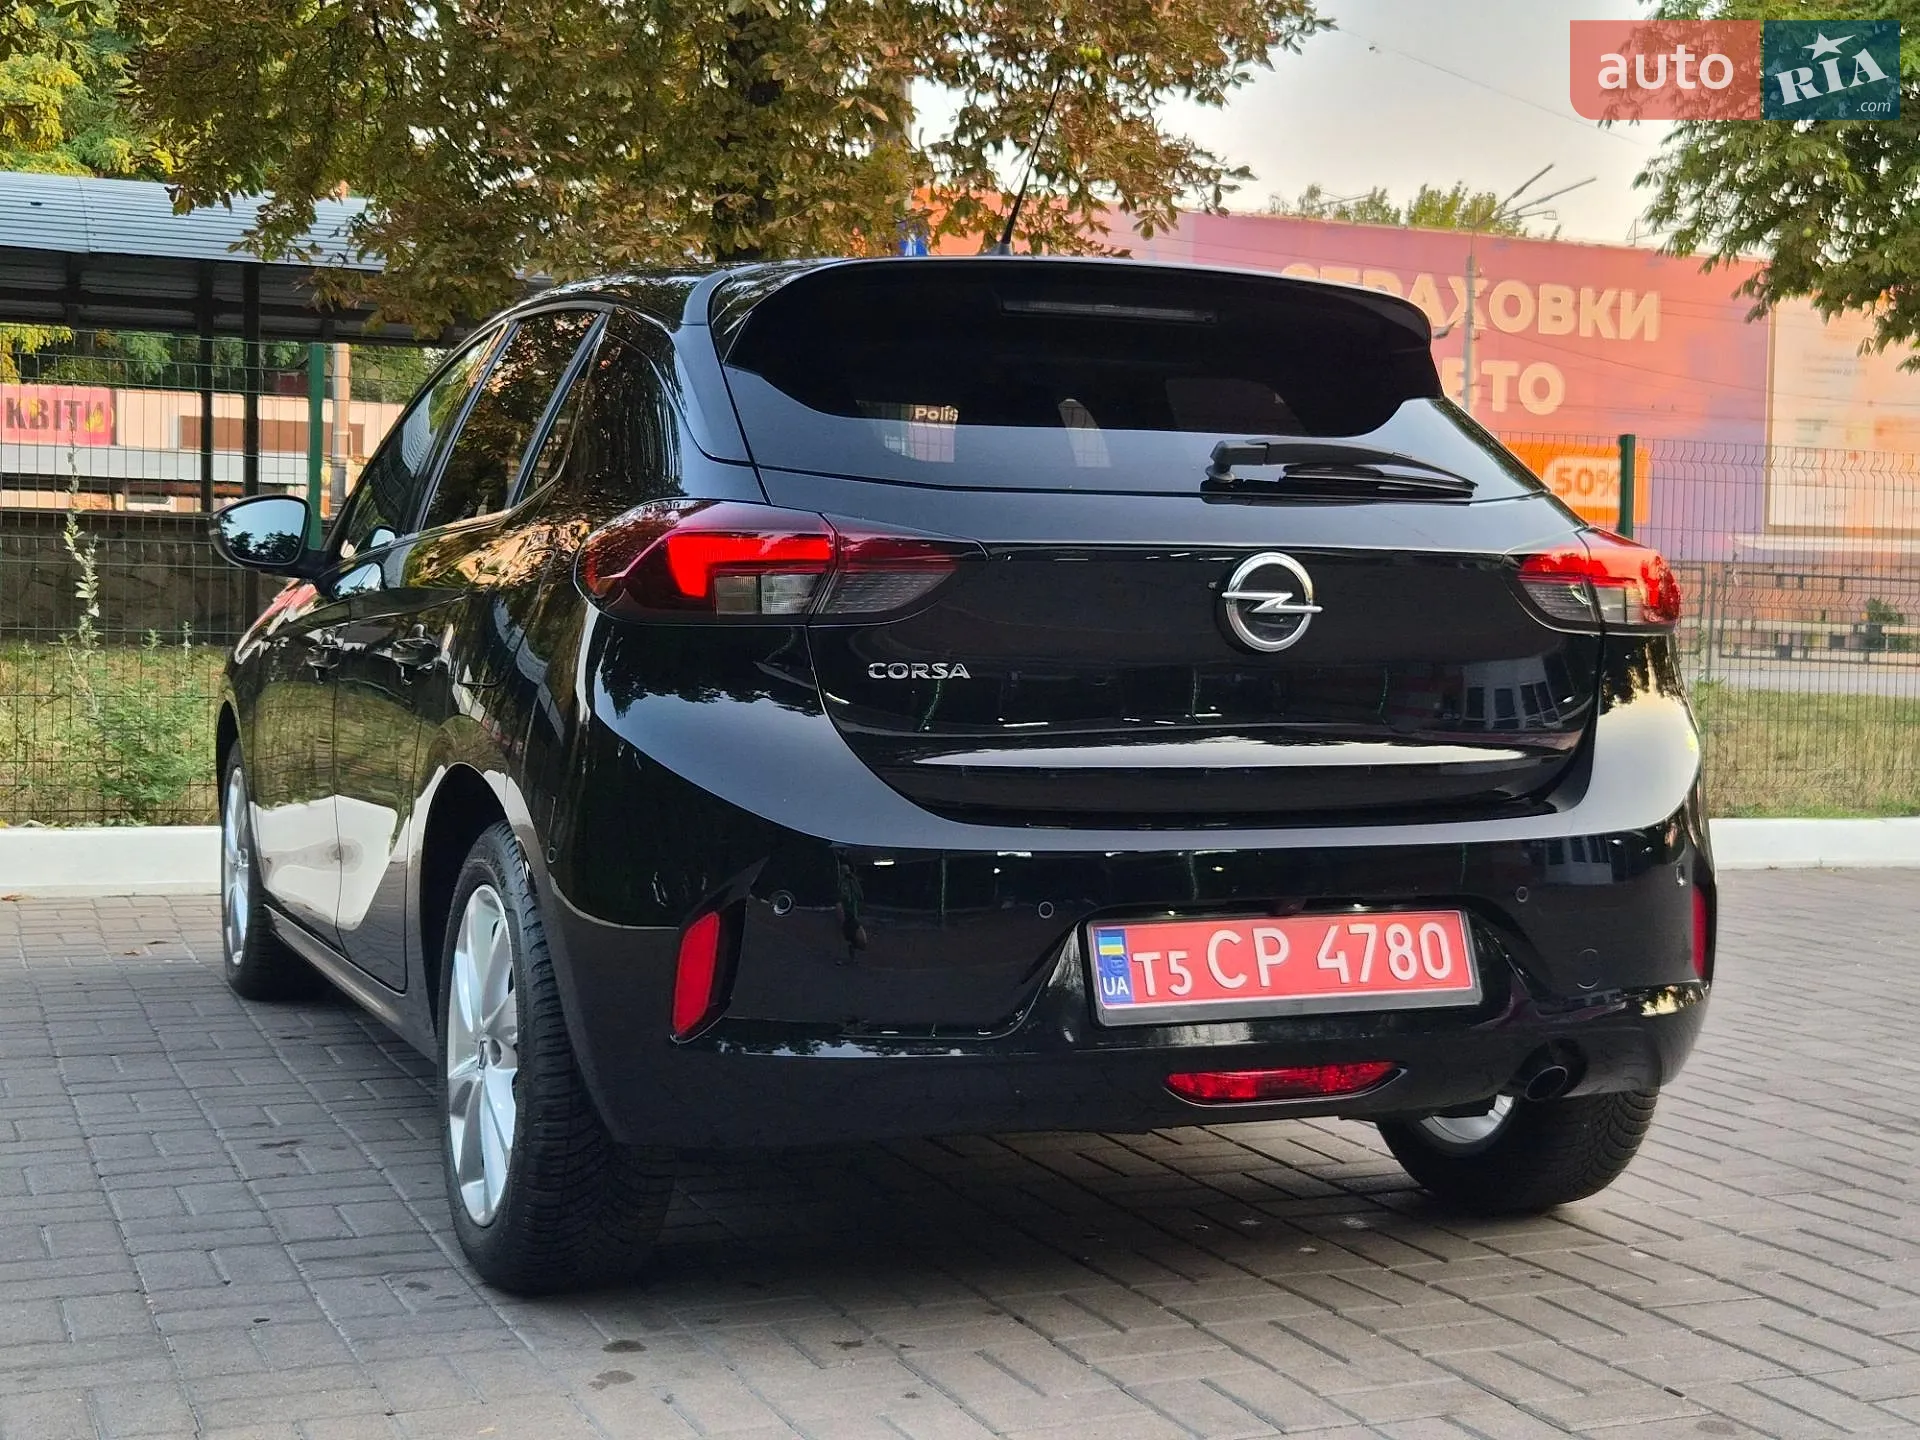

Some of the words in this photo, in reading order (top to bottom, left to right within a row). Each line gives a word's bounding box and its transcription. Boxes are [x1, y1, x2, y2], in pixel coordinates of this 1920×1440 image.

[1280, 262, 1661, 342] АХОВКИ
[1440, 357, 1565, 415] ВТО
[867, 662, 972, 680] CORSA
[1103, 976, 1129, 996] UA
[1132, 951, 1193, 996] T5
[1207, 927, 1290, 989] CP
[1316, 921, 1451, 984] 4780
